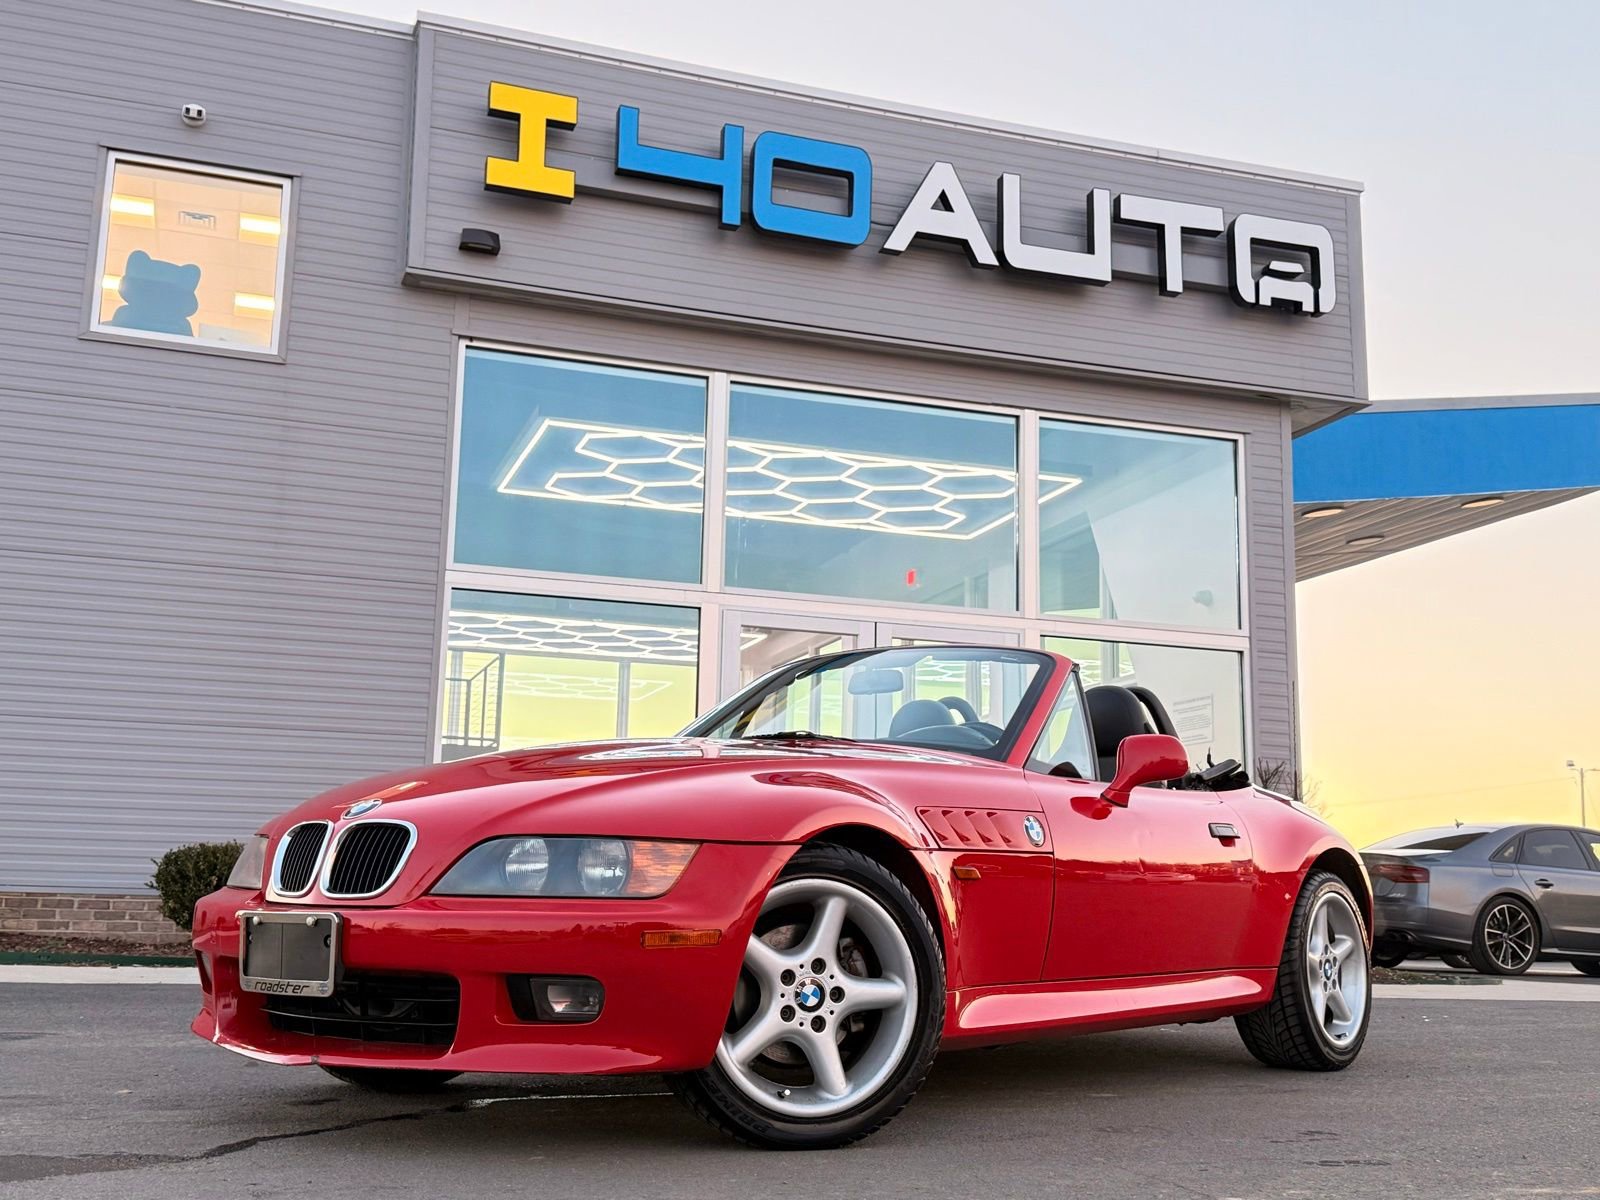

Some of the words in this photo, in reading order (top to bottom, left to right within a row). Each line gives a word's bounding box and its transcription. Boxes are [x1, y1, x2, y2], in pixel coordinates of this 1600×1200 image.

[485, 81, 578, 203] I
[615, 105, 872, 248] 40
[881, 161, 1336, 316] AUTO
[254, 981, 310, 994] roadster
